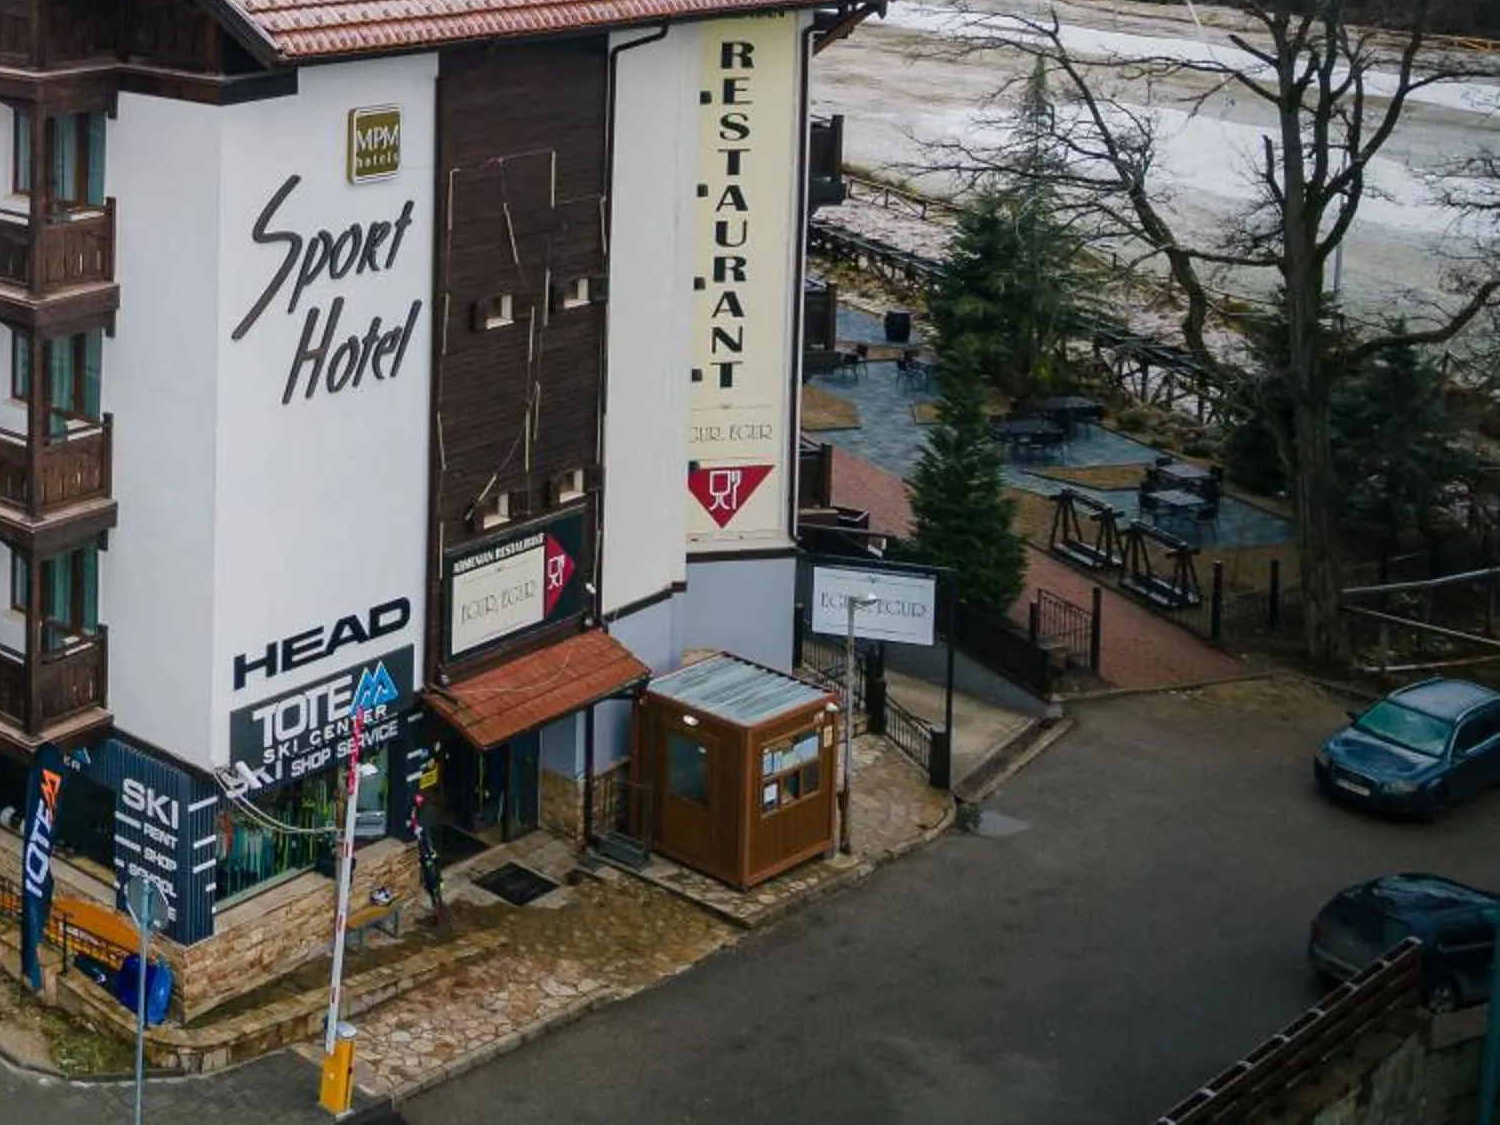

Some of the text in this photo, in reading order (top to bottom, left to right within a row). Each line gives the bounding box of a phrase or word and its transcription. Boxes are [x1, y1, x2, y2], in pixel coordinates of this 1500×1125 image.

[356, 126, 399, 152] MPM
[356, 152, 399, 169] hotels
[710, 41, 755, 388] RESTAURANT
[282, 296, 422, 405] Hotel
[233, 596, 411, 691] HEAD
[263, 738, 298, 764] SKI
[291, 748, 331, 777] SHOP
[122, 778, 179, 830] SKI
[143, 822, 179, 850] RENT
[143, 846, 177, 873] SHOP
